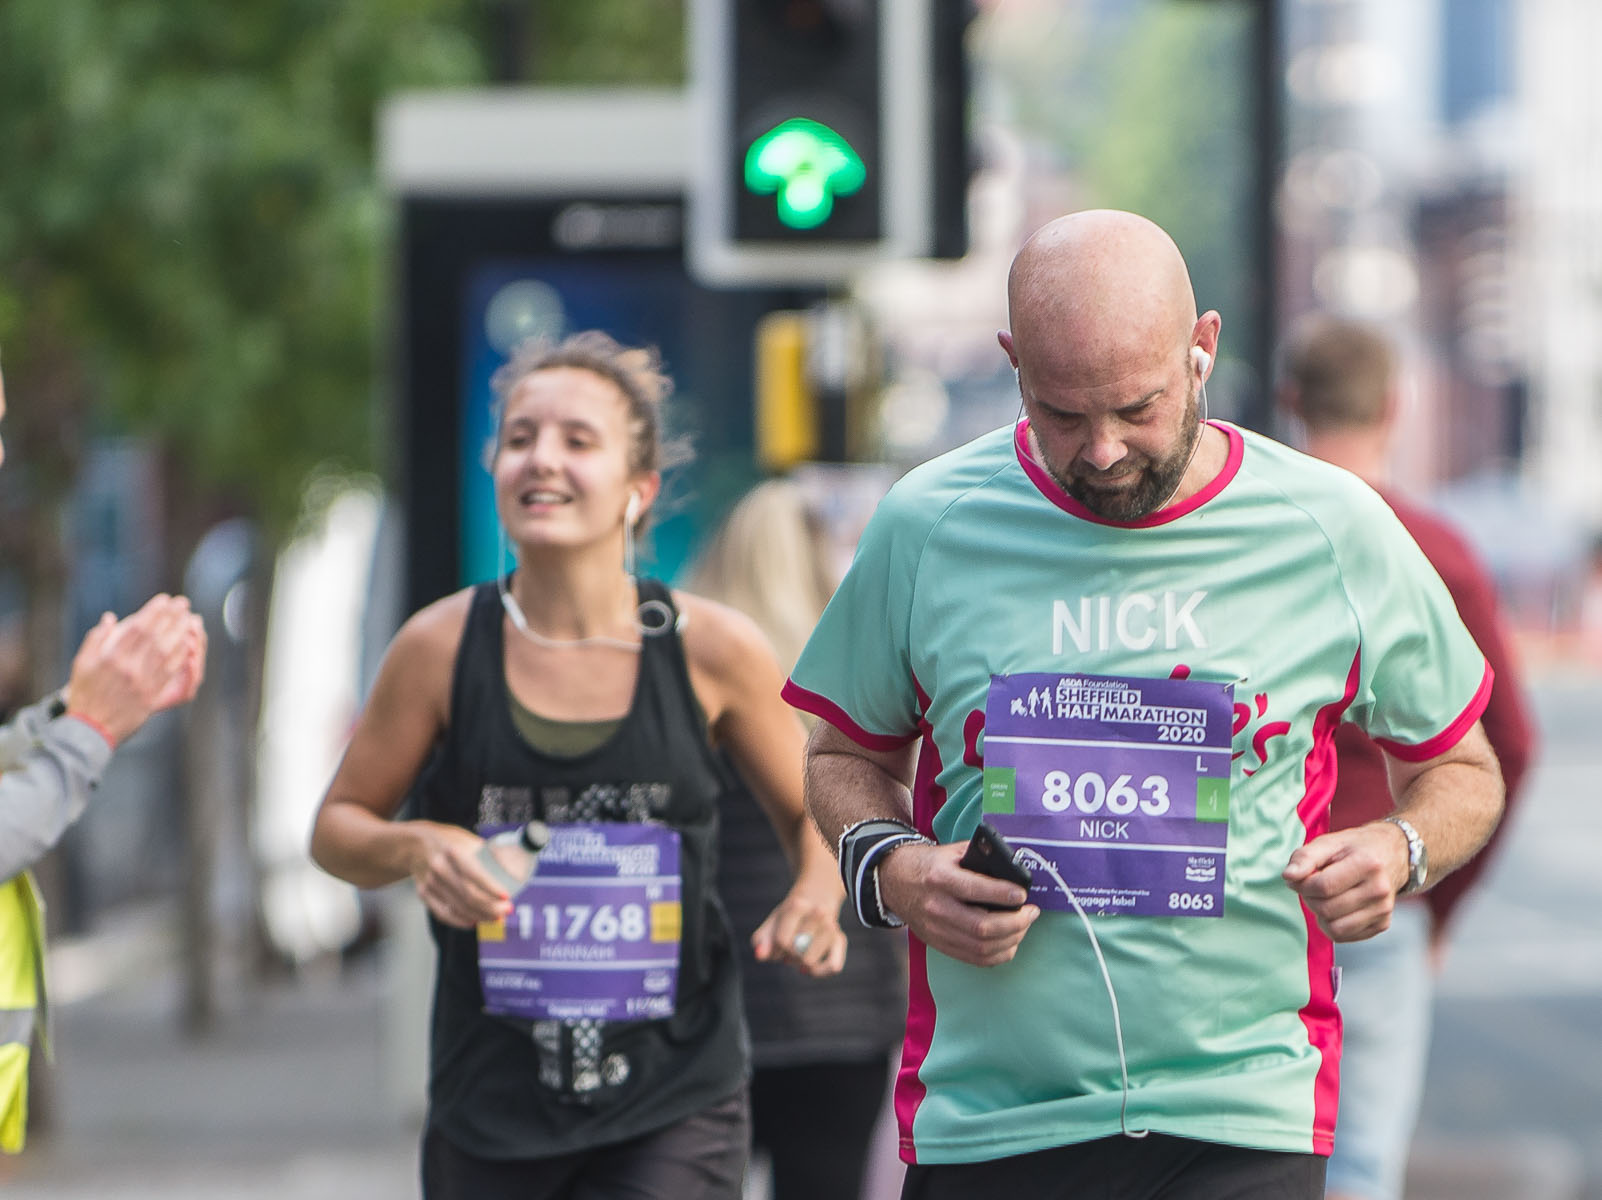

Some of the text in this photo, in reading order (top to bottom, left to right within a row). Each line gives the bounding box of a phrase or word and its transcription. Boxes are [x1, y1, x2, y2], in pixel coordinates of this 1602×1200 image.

[1052, 591, 1208, 656] NICK
[1059, 678, 1129, 691] ASDA Foundation
[1058, 687, 1139, 705] SHEFFIELD
[1057, 703, 1205, 725] HALF MARATHON
[1157, 725, 1206, 743] 2020
[1196, 755, 1208, 772] L
[1041, 770, 1171, 817] 8063
[1079, 819, 1130, 840] NICK
[1068, 895, 1136, 907] aggage label
[1168, 892, 1214, 910] 8063
[516, 903, 646, 942] 11768
